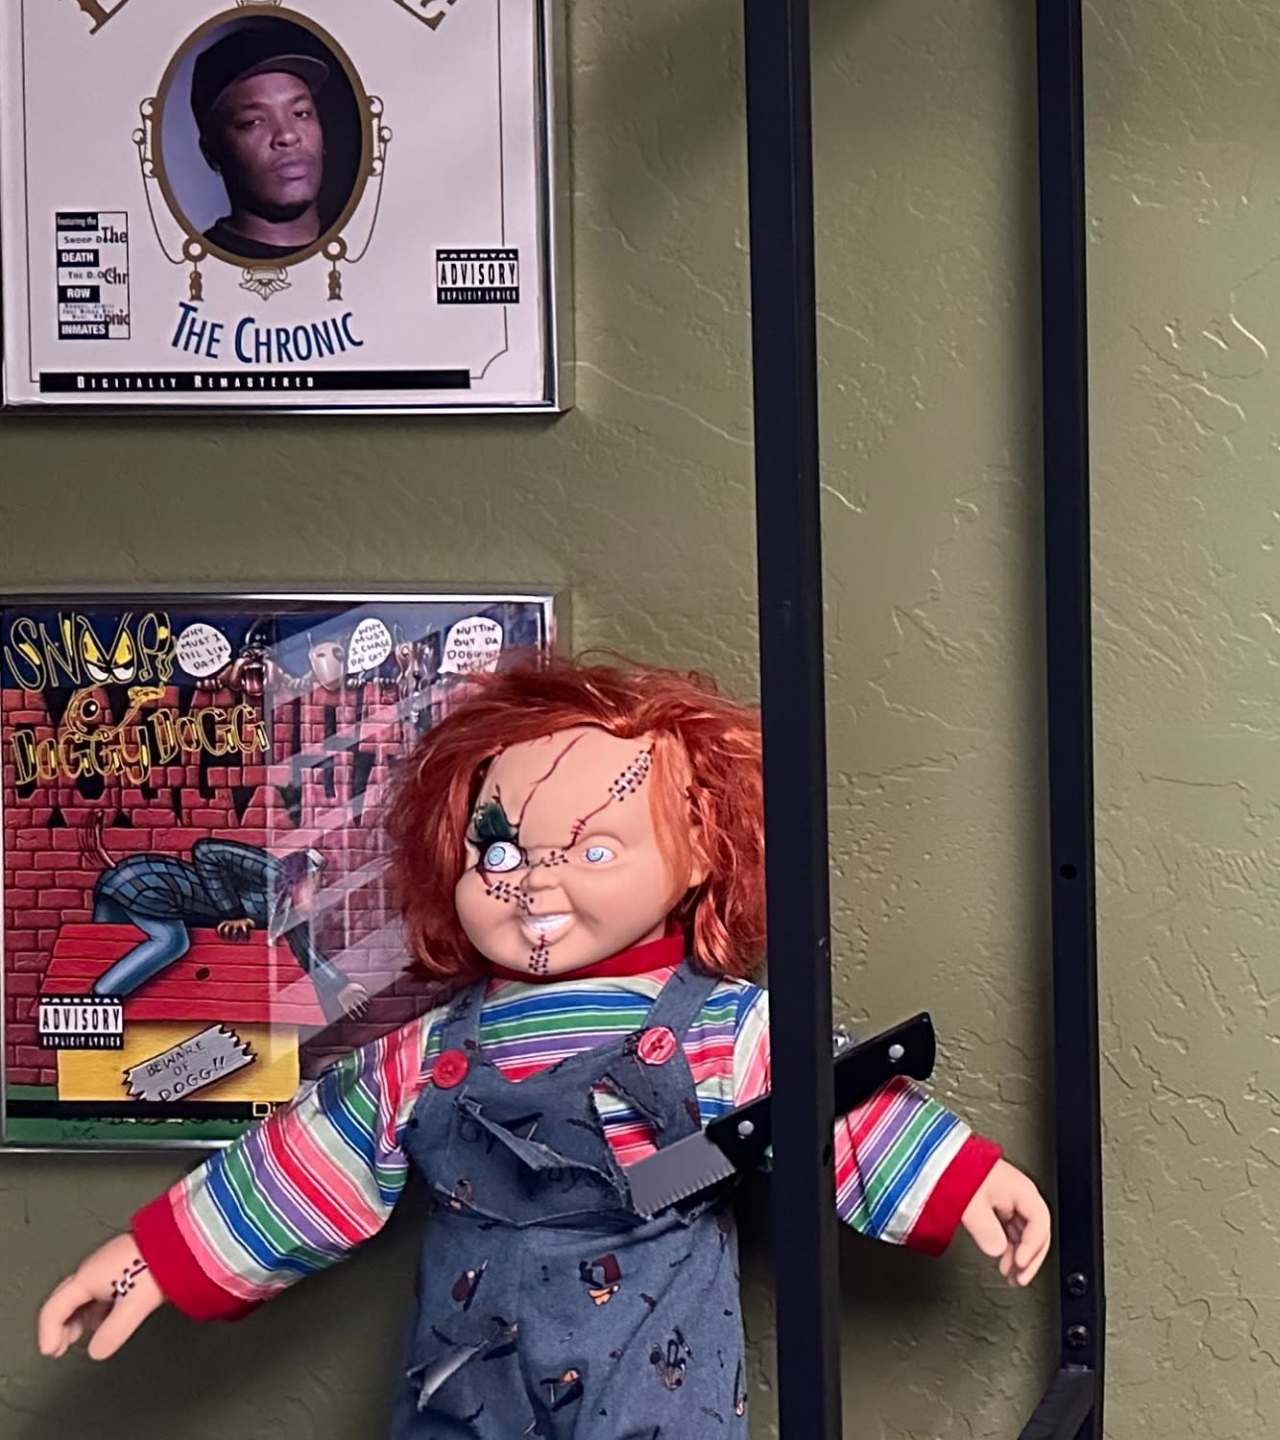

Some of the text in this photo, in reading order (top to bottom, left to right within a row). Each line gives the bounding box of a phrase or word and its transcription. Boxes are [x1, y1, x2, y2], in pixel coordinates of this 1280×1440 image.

[61, 252, 94, 263] DEATH
[440, 262, 515, 285] ADVISORY
[67, 288, 91, 299] ROW
[61, 324, 106, 335] INMATES
[42, 1007, 120, 1031] ADVISORY
[146, 1040, 205, 1077] BEWARE
[173, 1063, 190, 1076] OF
